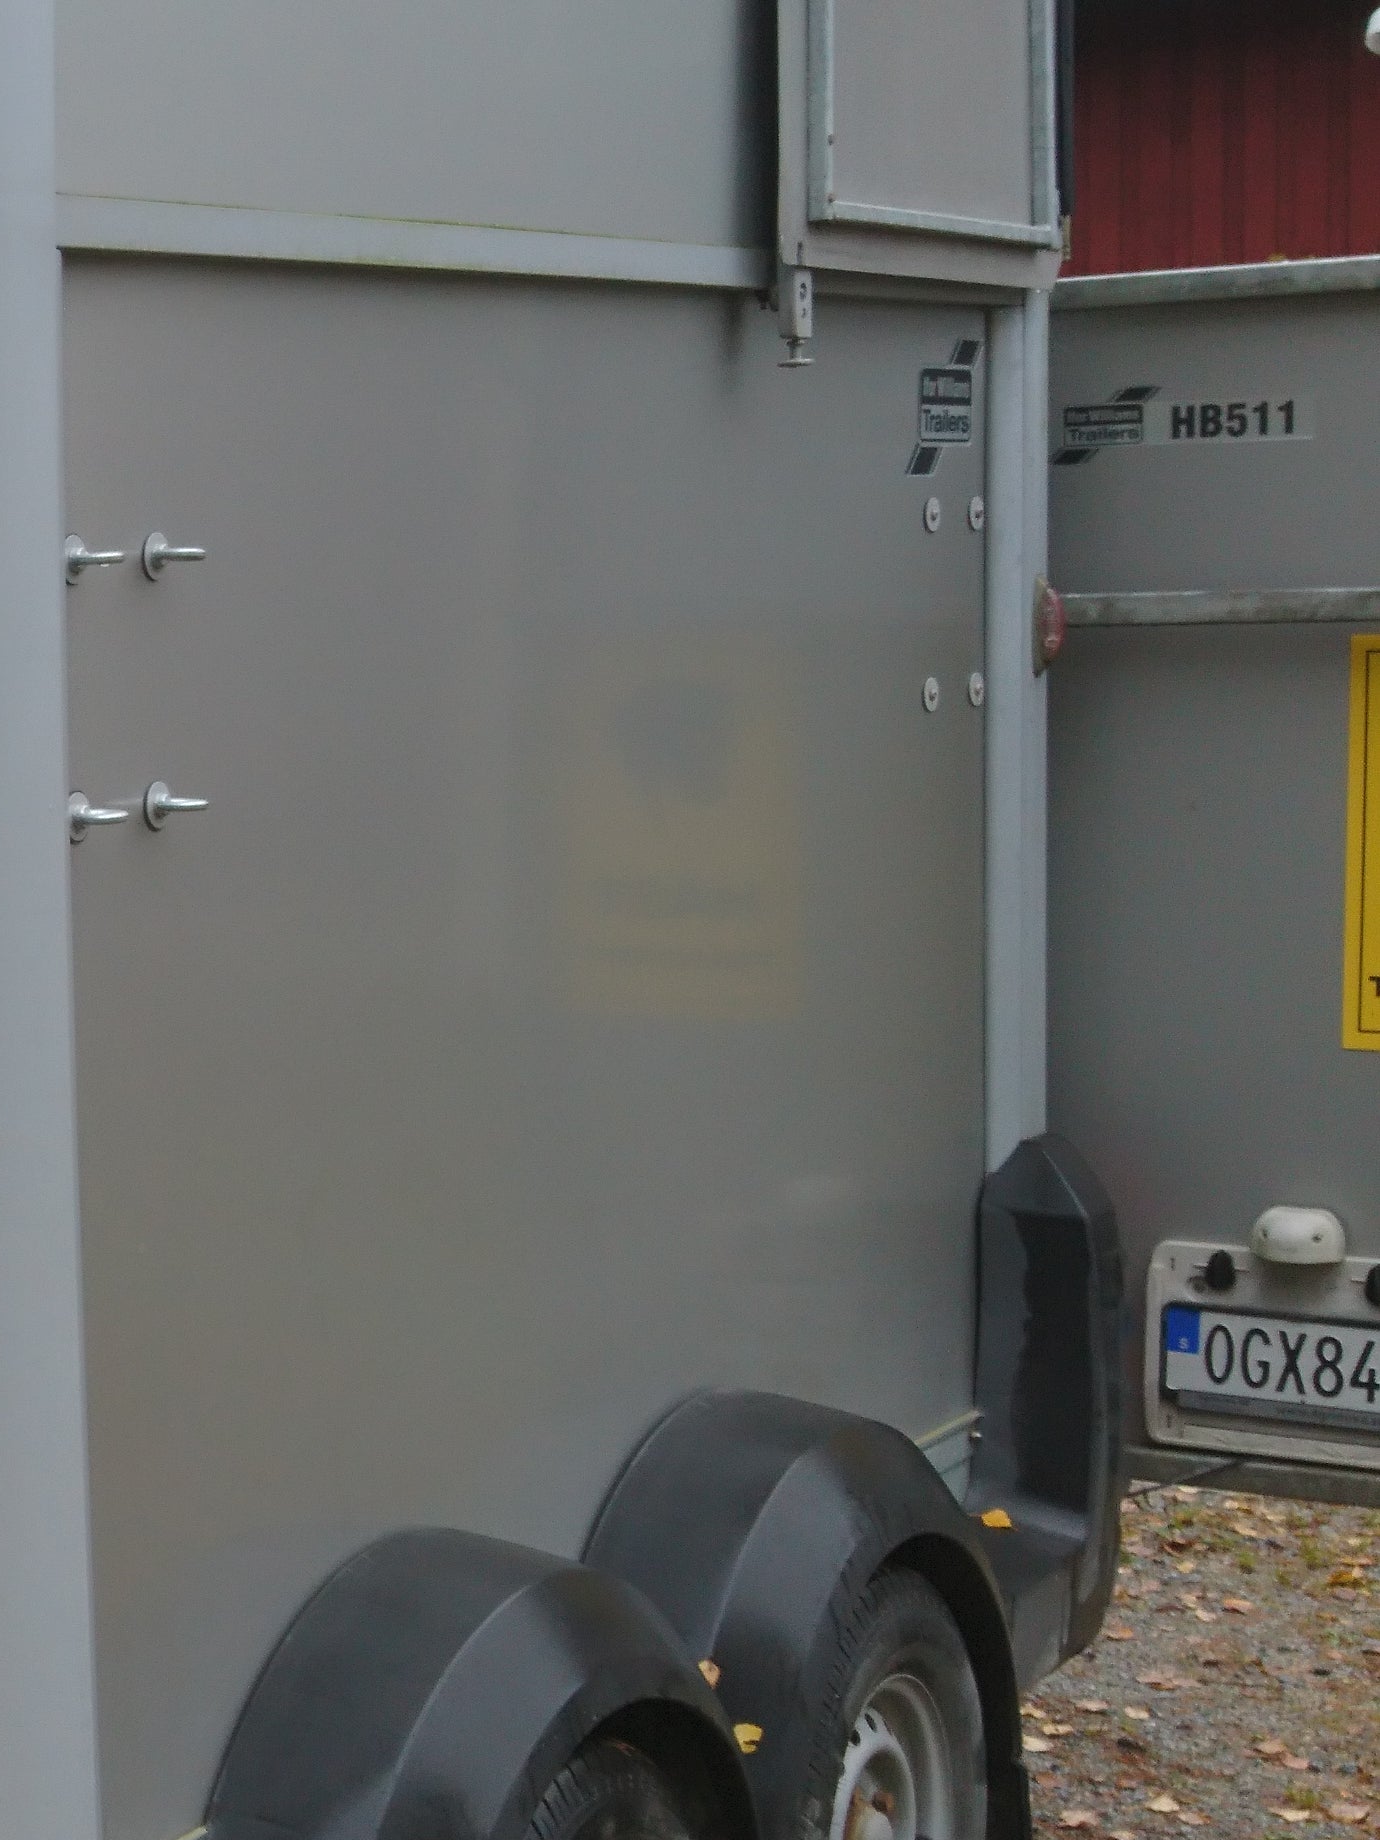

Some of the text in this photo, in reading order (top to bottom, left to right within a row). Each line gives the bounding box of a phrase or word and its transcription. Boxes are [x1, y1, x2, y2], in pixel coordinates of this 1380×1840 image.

[923, 408, 970, 434] Trailers
[1170, 399, 1295, 440] HB511
[1177, 1337, 1189, 1350] S
